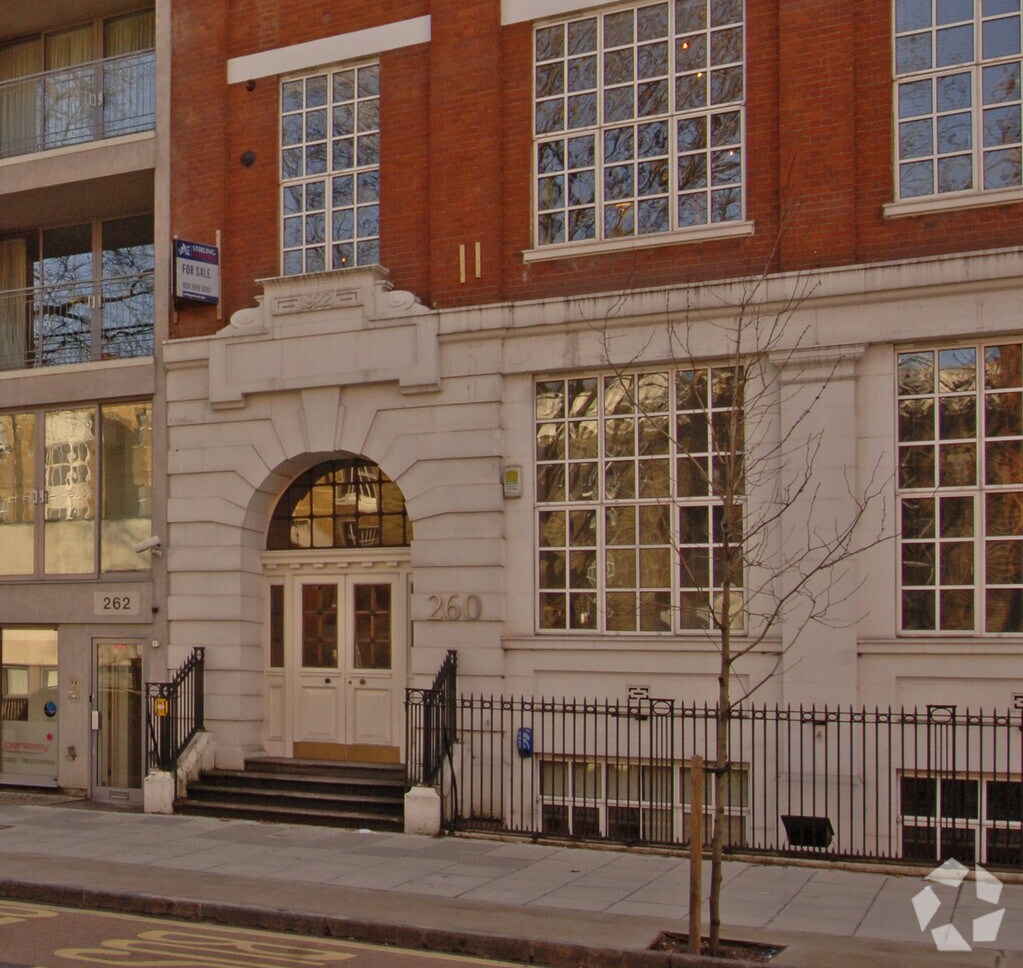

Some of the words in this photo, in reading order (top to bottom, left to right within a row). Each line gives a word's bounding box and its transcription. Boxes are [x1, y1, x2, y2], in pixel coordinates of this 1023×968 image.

[182, 263, 194, 275] FOR
[196, 266, 211, 279] SALE
[103, 597, 130, 610] 262
[428, 593, 482, 621] 260
